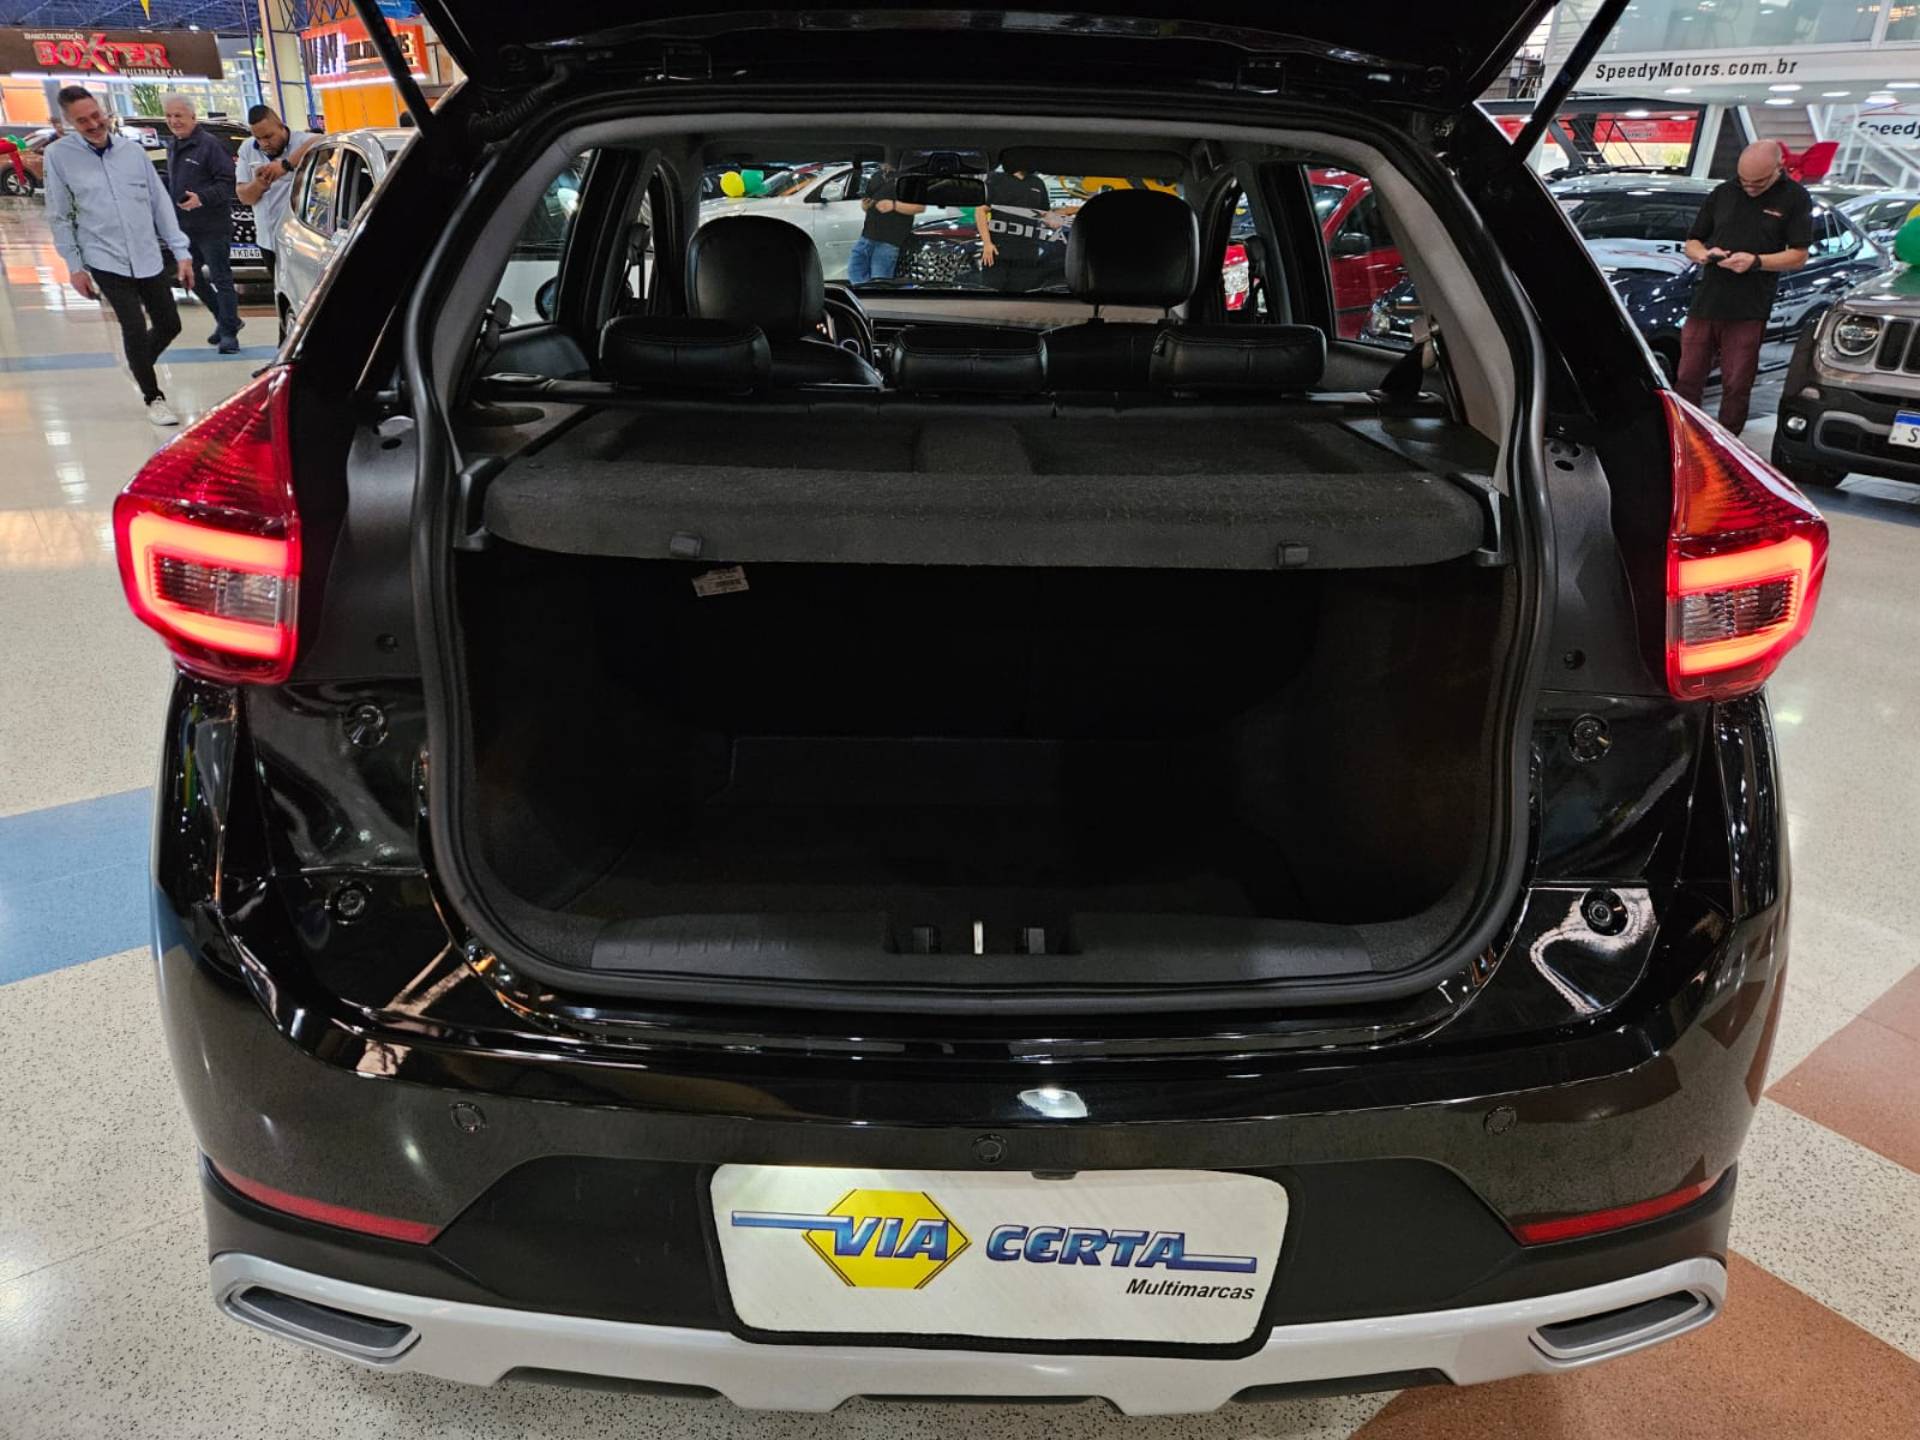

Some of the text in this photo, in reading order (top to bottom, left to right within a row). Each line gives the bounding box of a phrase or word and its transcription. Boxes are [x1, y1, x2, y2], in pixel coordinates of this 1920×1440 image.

[33, 33, 172, 74] BOXTER
[119, 67, 184, 77] MULTIMARCAS
[1595, 58, 1798, 82] SpeedyMotors.com.br
[834, 1216, 1186, 1270] VIA CERTA
[1126, 1278, 1255, 1300] Multimarcas
